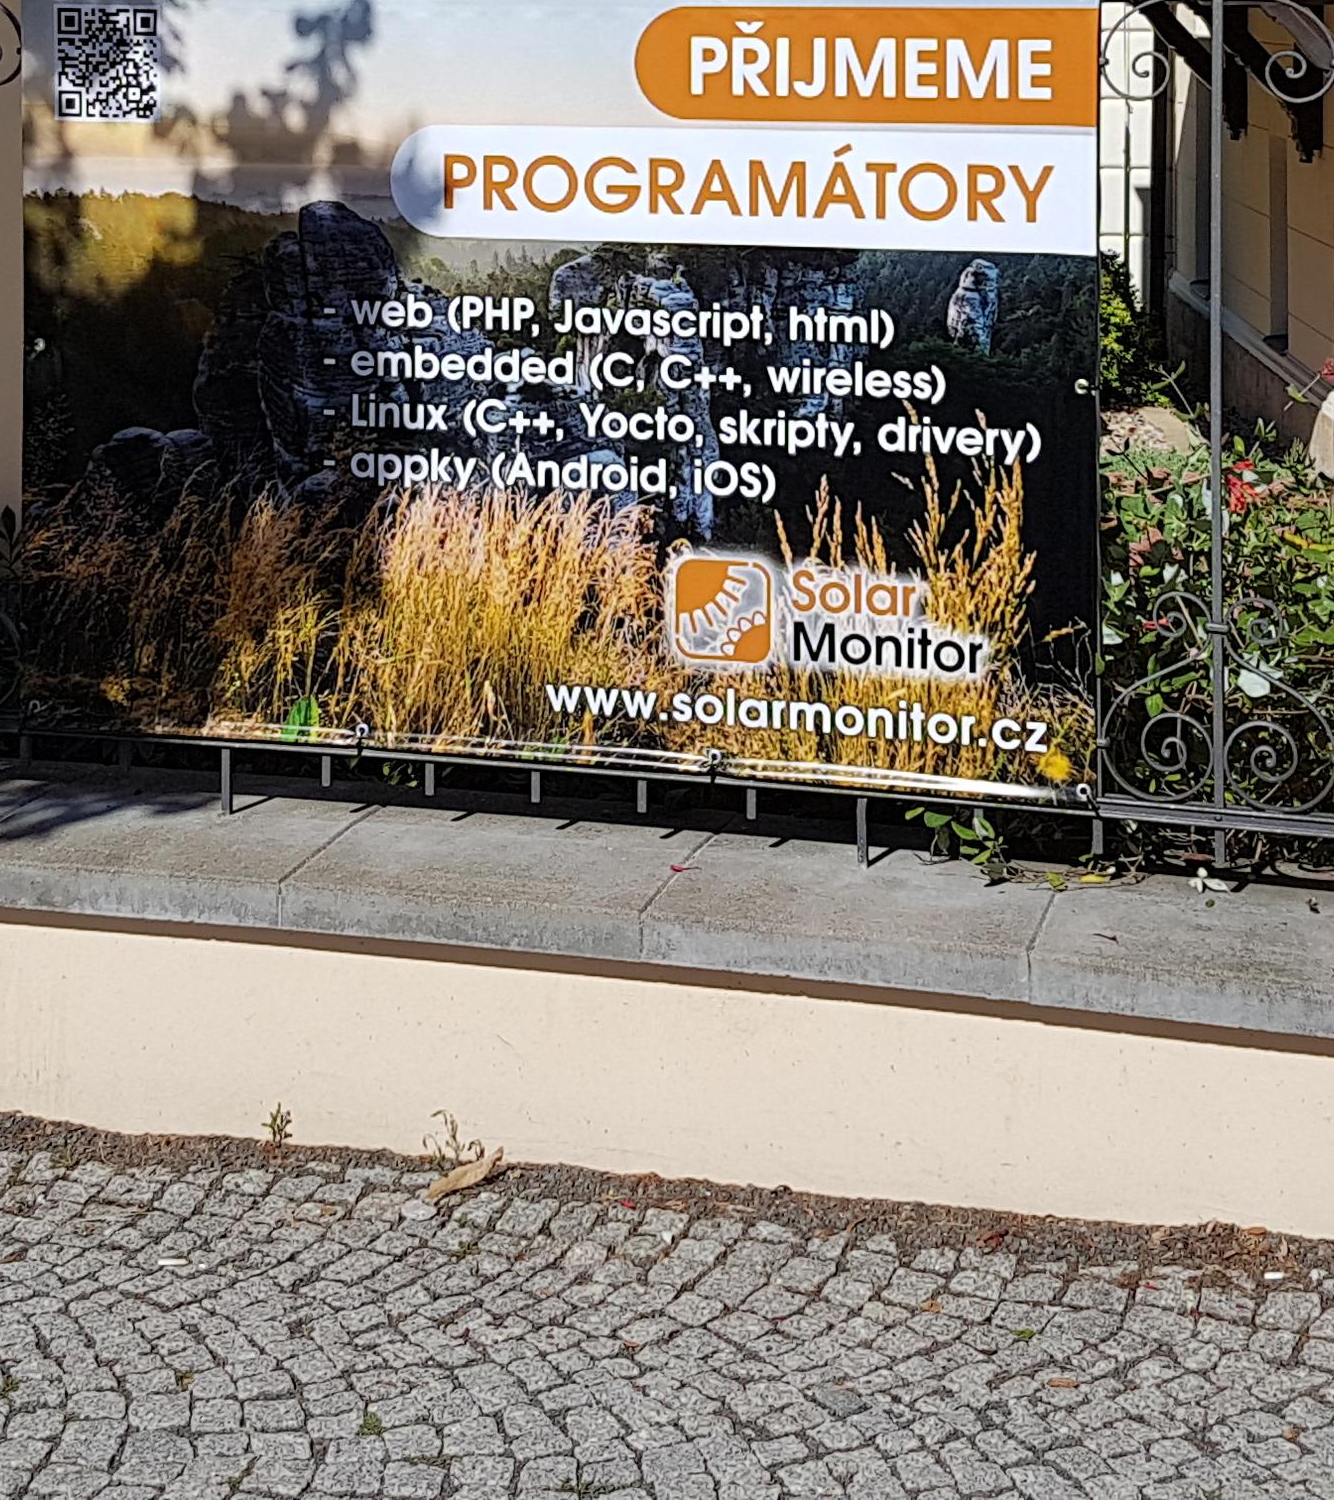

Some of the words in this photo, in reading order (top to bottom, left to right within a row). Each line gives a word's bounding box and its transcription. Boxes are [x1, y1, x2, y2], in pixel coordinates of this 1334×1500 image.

[690, 21, 1052, 100] PŘIJMEME
[443, 143, 1055, 224] PROGRAMÁTORY
[351, 294, 433, 328] web
[447, 295, 540, 337] (PHP,
[554, 299, 773, 347] Javascript,
[789, 306, 895, 349] html)
[351, 346, 575, 385] embedded
[590, 351, 645, 391] (C,
[660, 355, 752, 398] C++,
[767, 358, 947, 405] wireless)
[351, 393, 448, 431] Linux
[463, 398, 565, 442] (C++,
[579, 402, 704, 448] Yocto,
[719, 409, 862, 457] skripty,
[877, 416, 1042, 466] drivery)
[350, 448, 476, 491] appky
[491, 451, 677, 499] (Android,
[694, 459, 777, 504] iOS)
[792, 569, 917, 617] Solar
[792, 620, 984, 674] Monitor
[546, 683, 1049, 754] www.solarmonitor.cz
